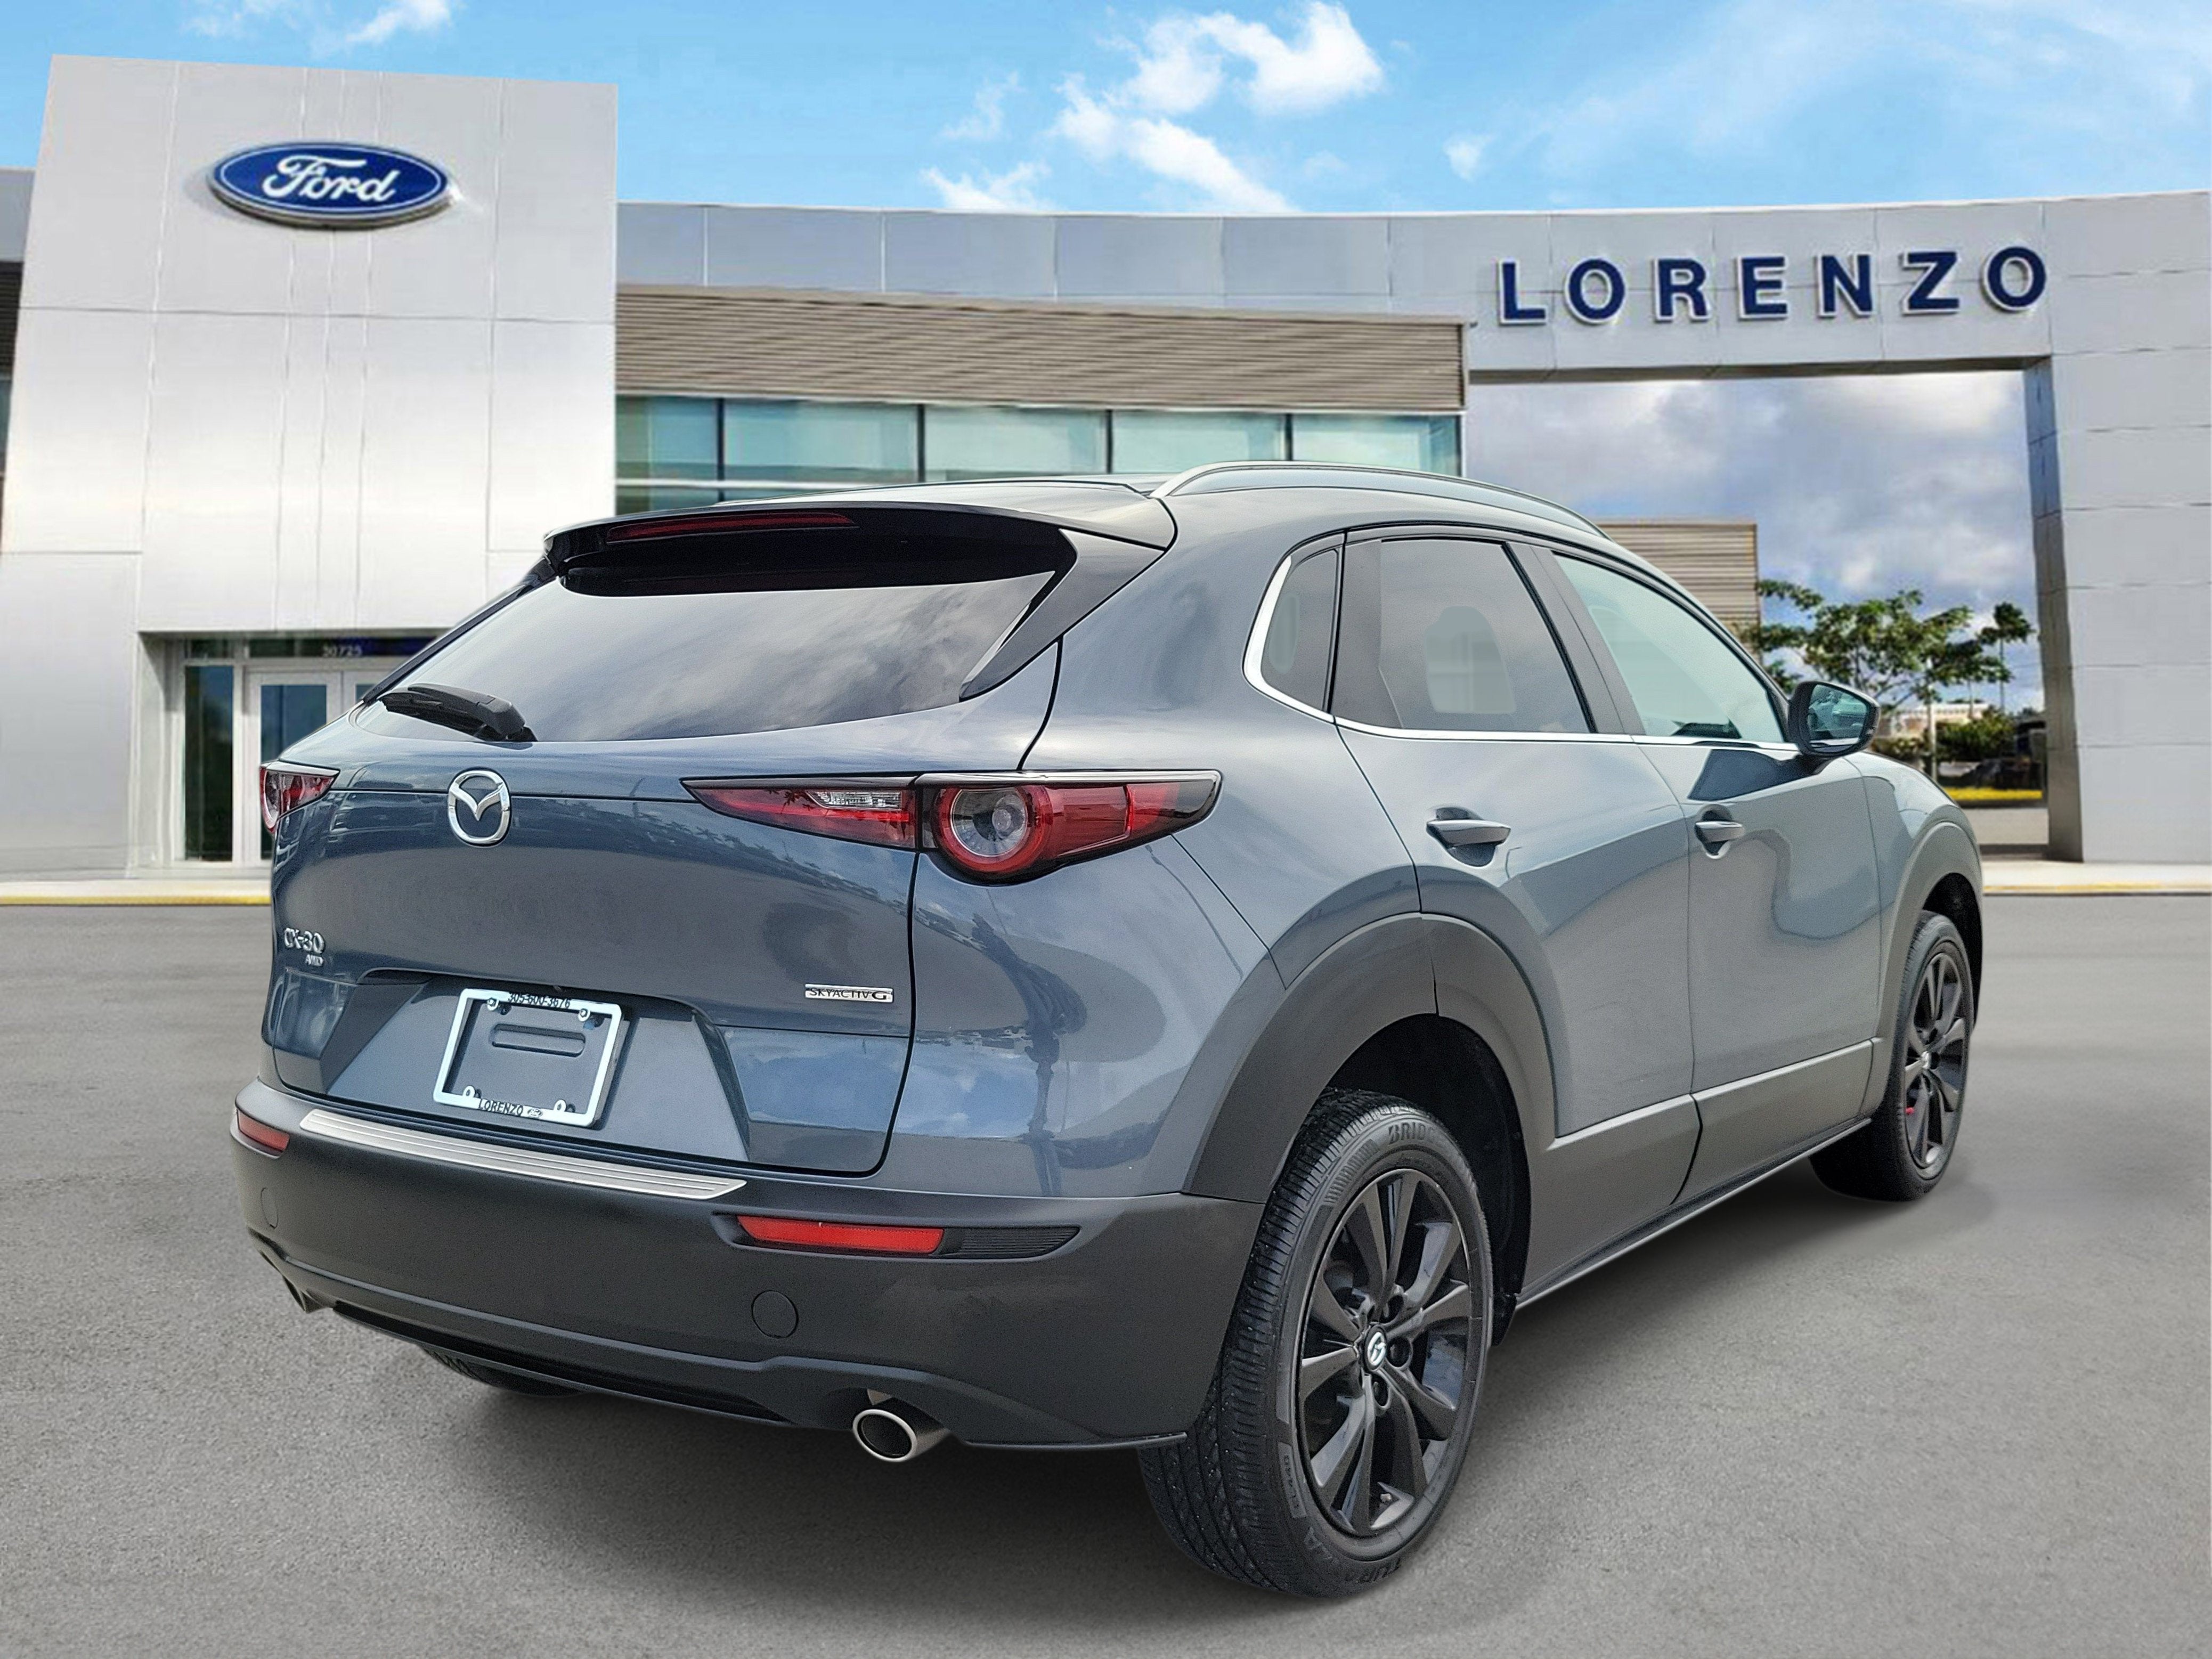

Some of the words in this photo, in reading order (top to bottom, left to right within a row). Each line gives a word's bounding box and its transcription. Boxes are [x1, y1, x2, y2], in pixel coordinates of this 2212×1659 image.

[262, 155, 400, 201] Ford
[1498, 247, 2048, 322] LORENZO
[284, 928, 325, 954] CX-30
[478, 1099, 523, 1116] LORENZO
